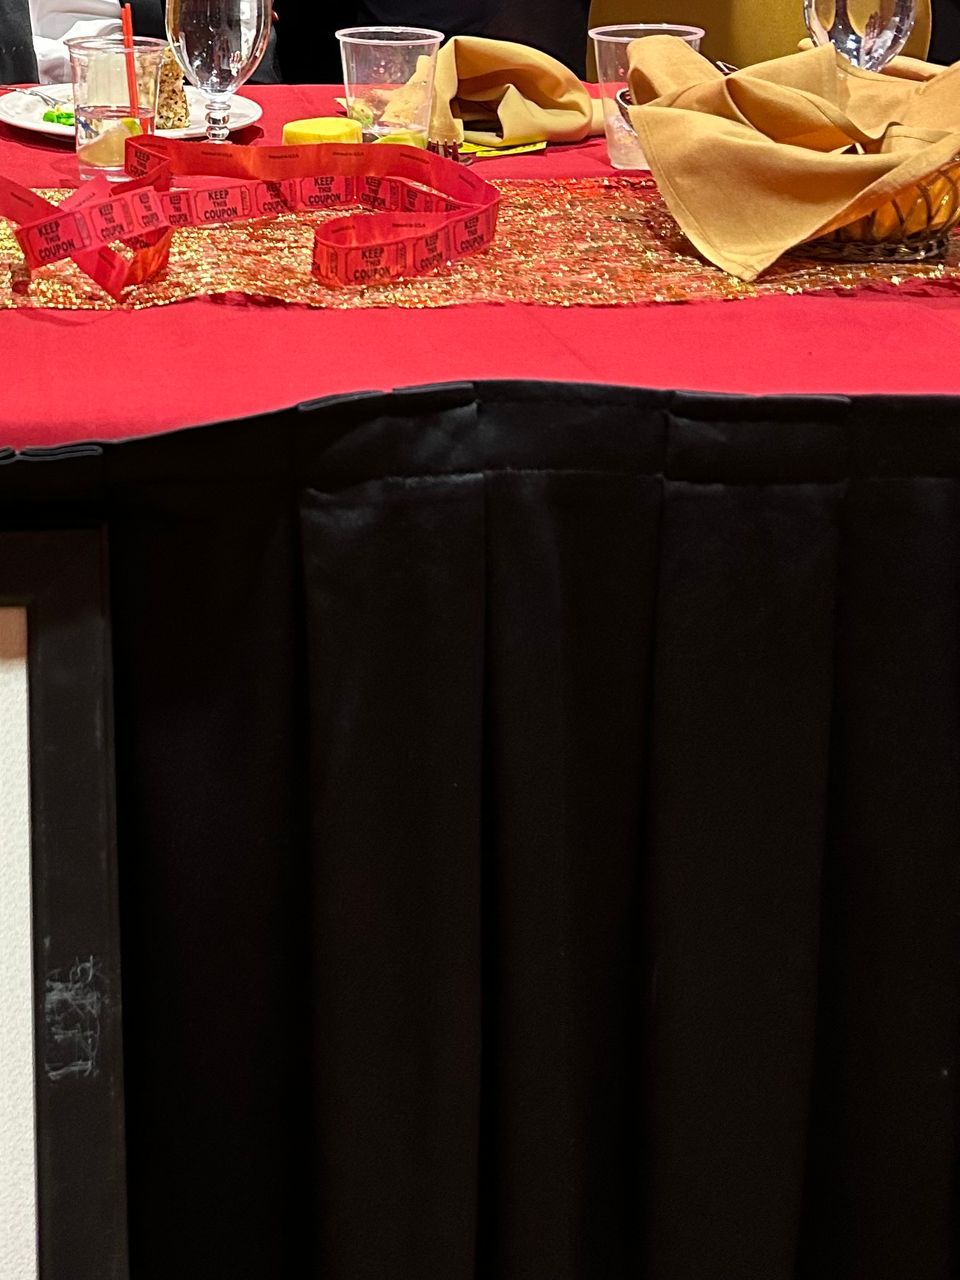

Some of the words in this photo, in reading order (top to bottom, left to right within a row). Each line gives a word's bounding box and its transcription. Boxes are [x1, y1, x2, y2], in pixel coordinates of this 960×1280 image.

[313, 176, 334, 186] KEEP
[208, 190, 229, 200] KEEP
[308, 193, 341, 205] COUPON
[204, 207, 238, 220] COUPON
[38, 220, 61, 236] KEEP
[44, 233, 61, 245] THIS
[39, 239, 76, 260] COUPON
[361, 247, 385, 260] KEEP
[365, 258, 381, 267] THIS
[353, 267, 391, 281] COUPON
